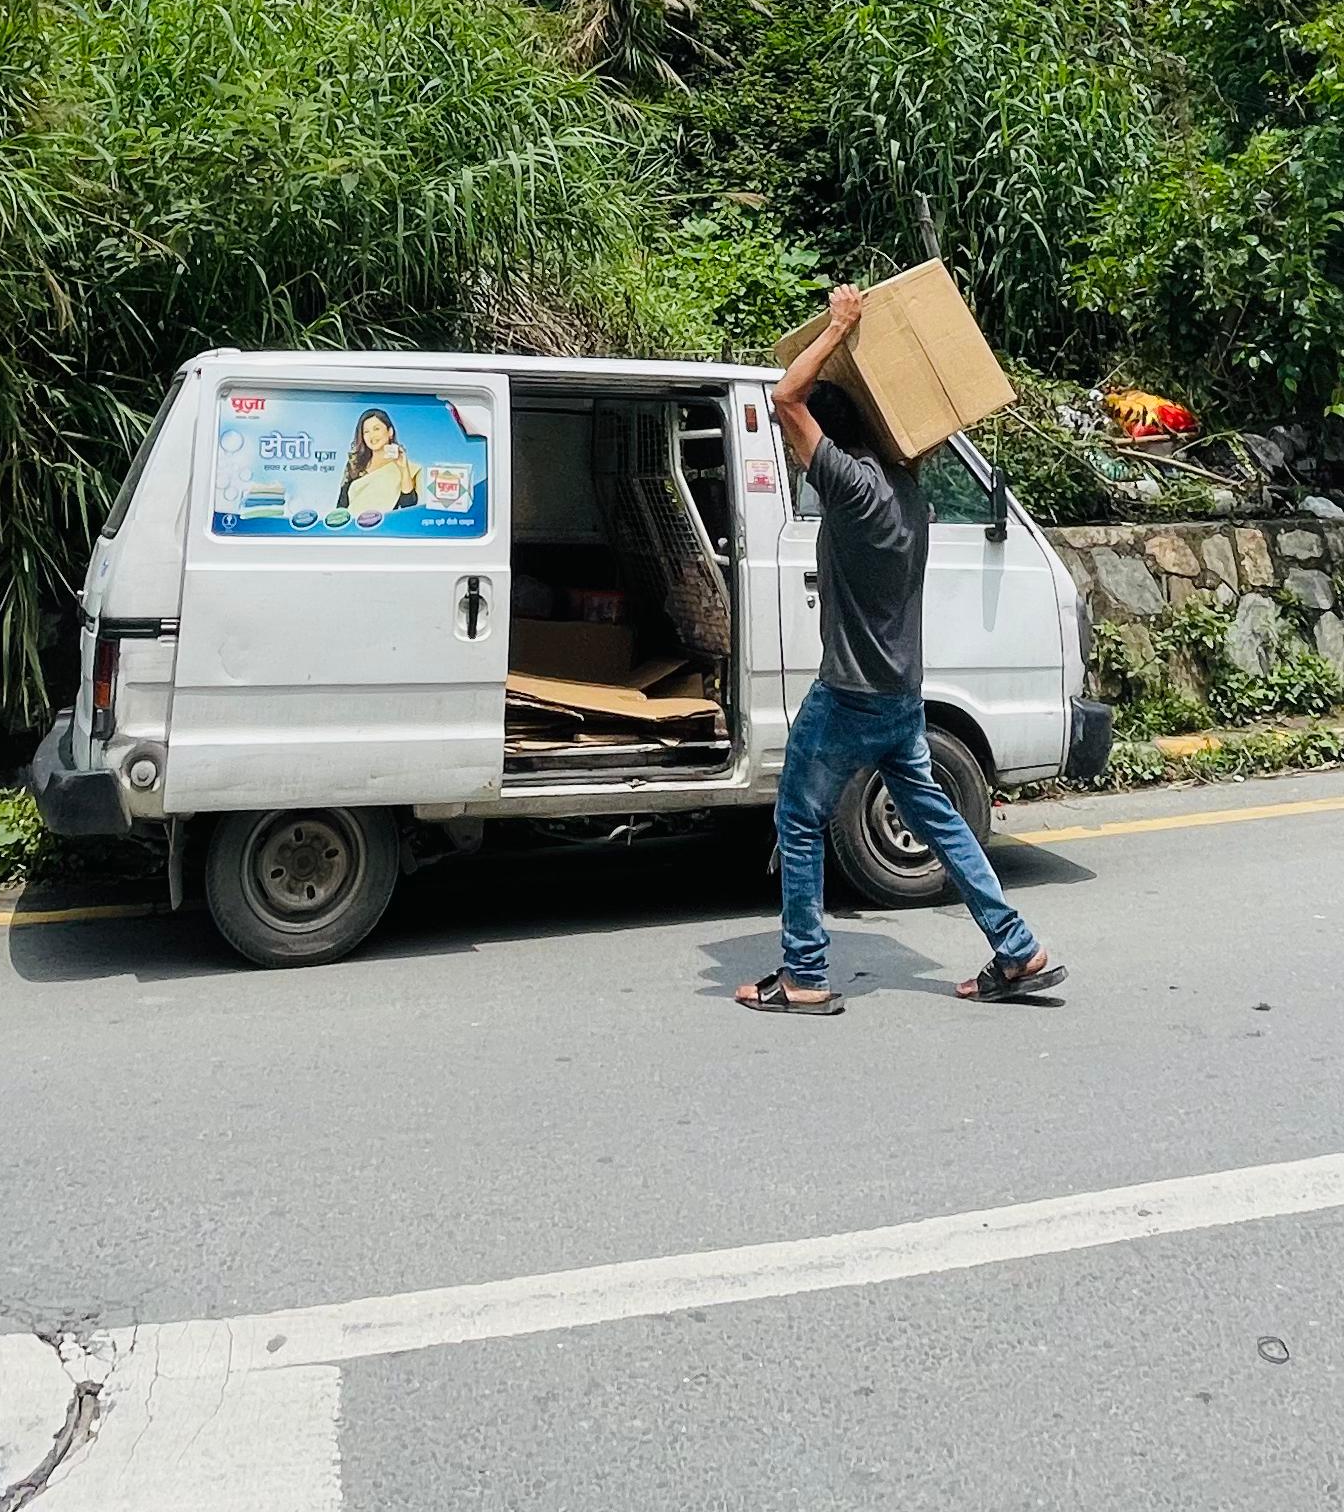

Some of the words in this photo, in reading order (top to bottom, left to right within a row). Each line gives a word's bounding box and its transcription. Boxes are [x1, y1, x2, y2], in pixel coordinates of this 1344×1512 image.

[230, 398, 266, 414] पूजा
[259, 430, 312, 460] सेतो
[314, 451, 337, 463] पूजा
